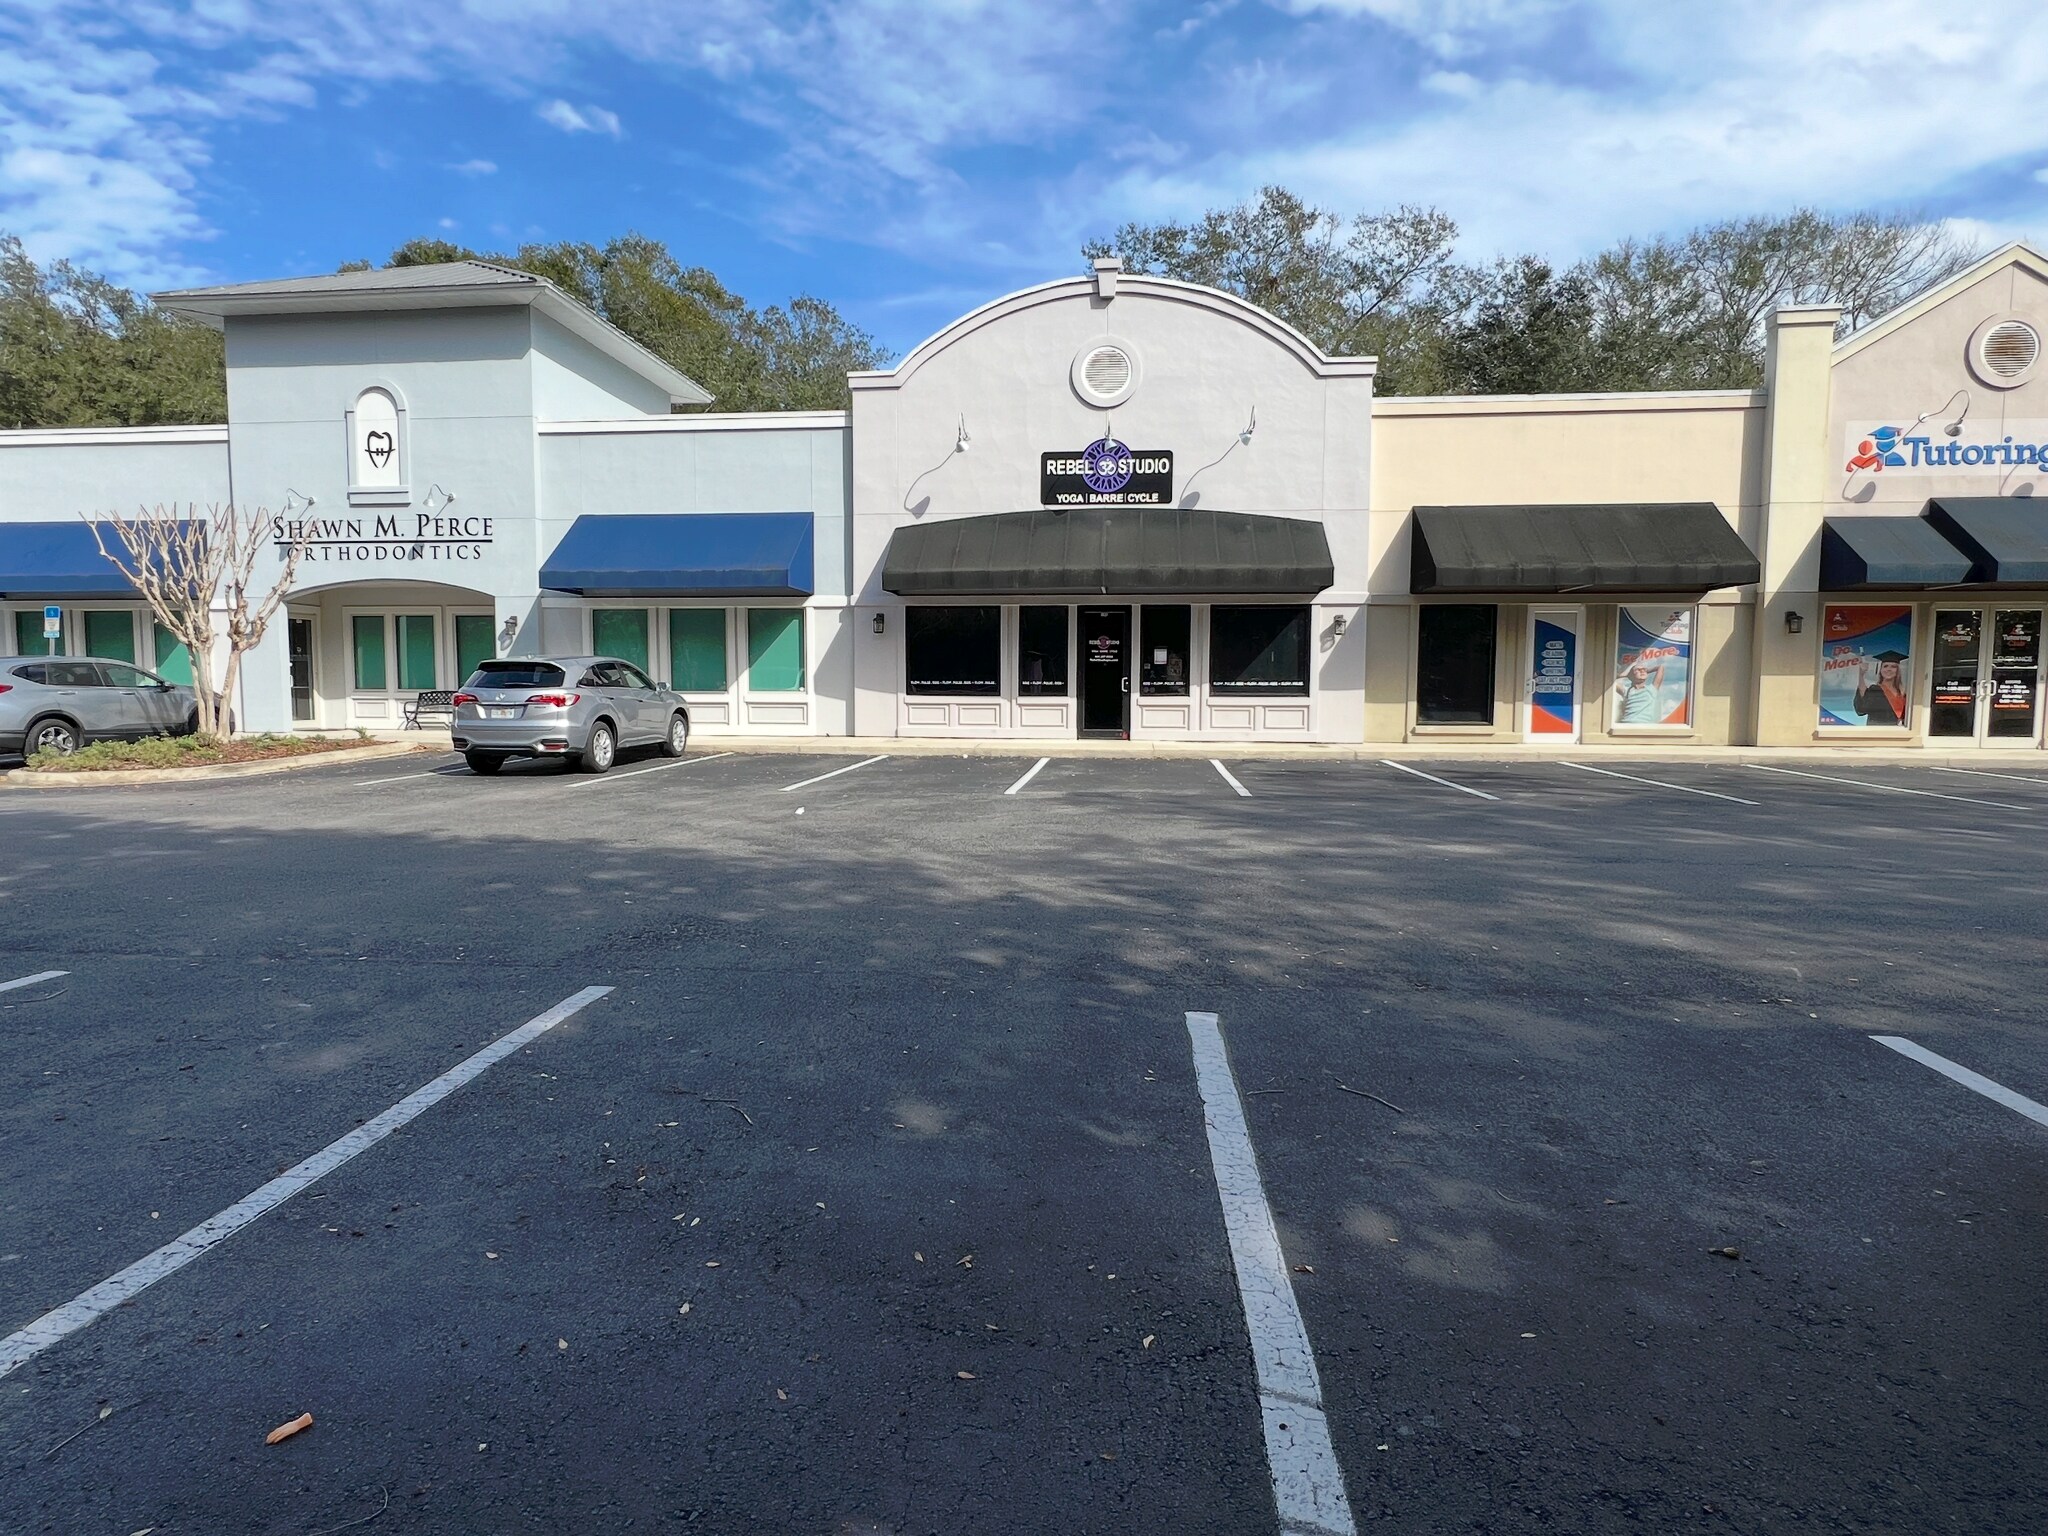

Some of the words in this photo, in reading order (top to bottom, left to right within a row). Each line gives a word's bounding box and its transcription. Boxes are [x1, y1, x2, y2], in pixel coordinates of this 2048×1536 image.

[1046, 459, 1094, 475] REBEL
[1117, 457, 1170, 475] STUDIO
[1056, 493, 1084, 503] YOGA
[1089, 493, 1124, 503] BARRE
[1127, 492, 1159, 503] CYCLE
[273, 516, 362, 539] SHAWN
[374, 514, 405, 538] M.
[416, 513, 493, 537] PERCE
